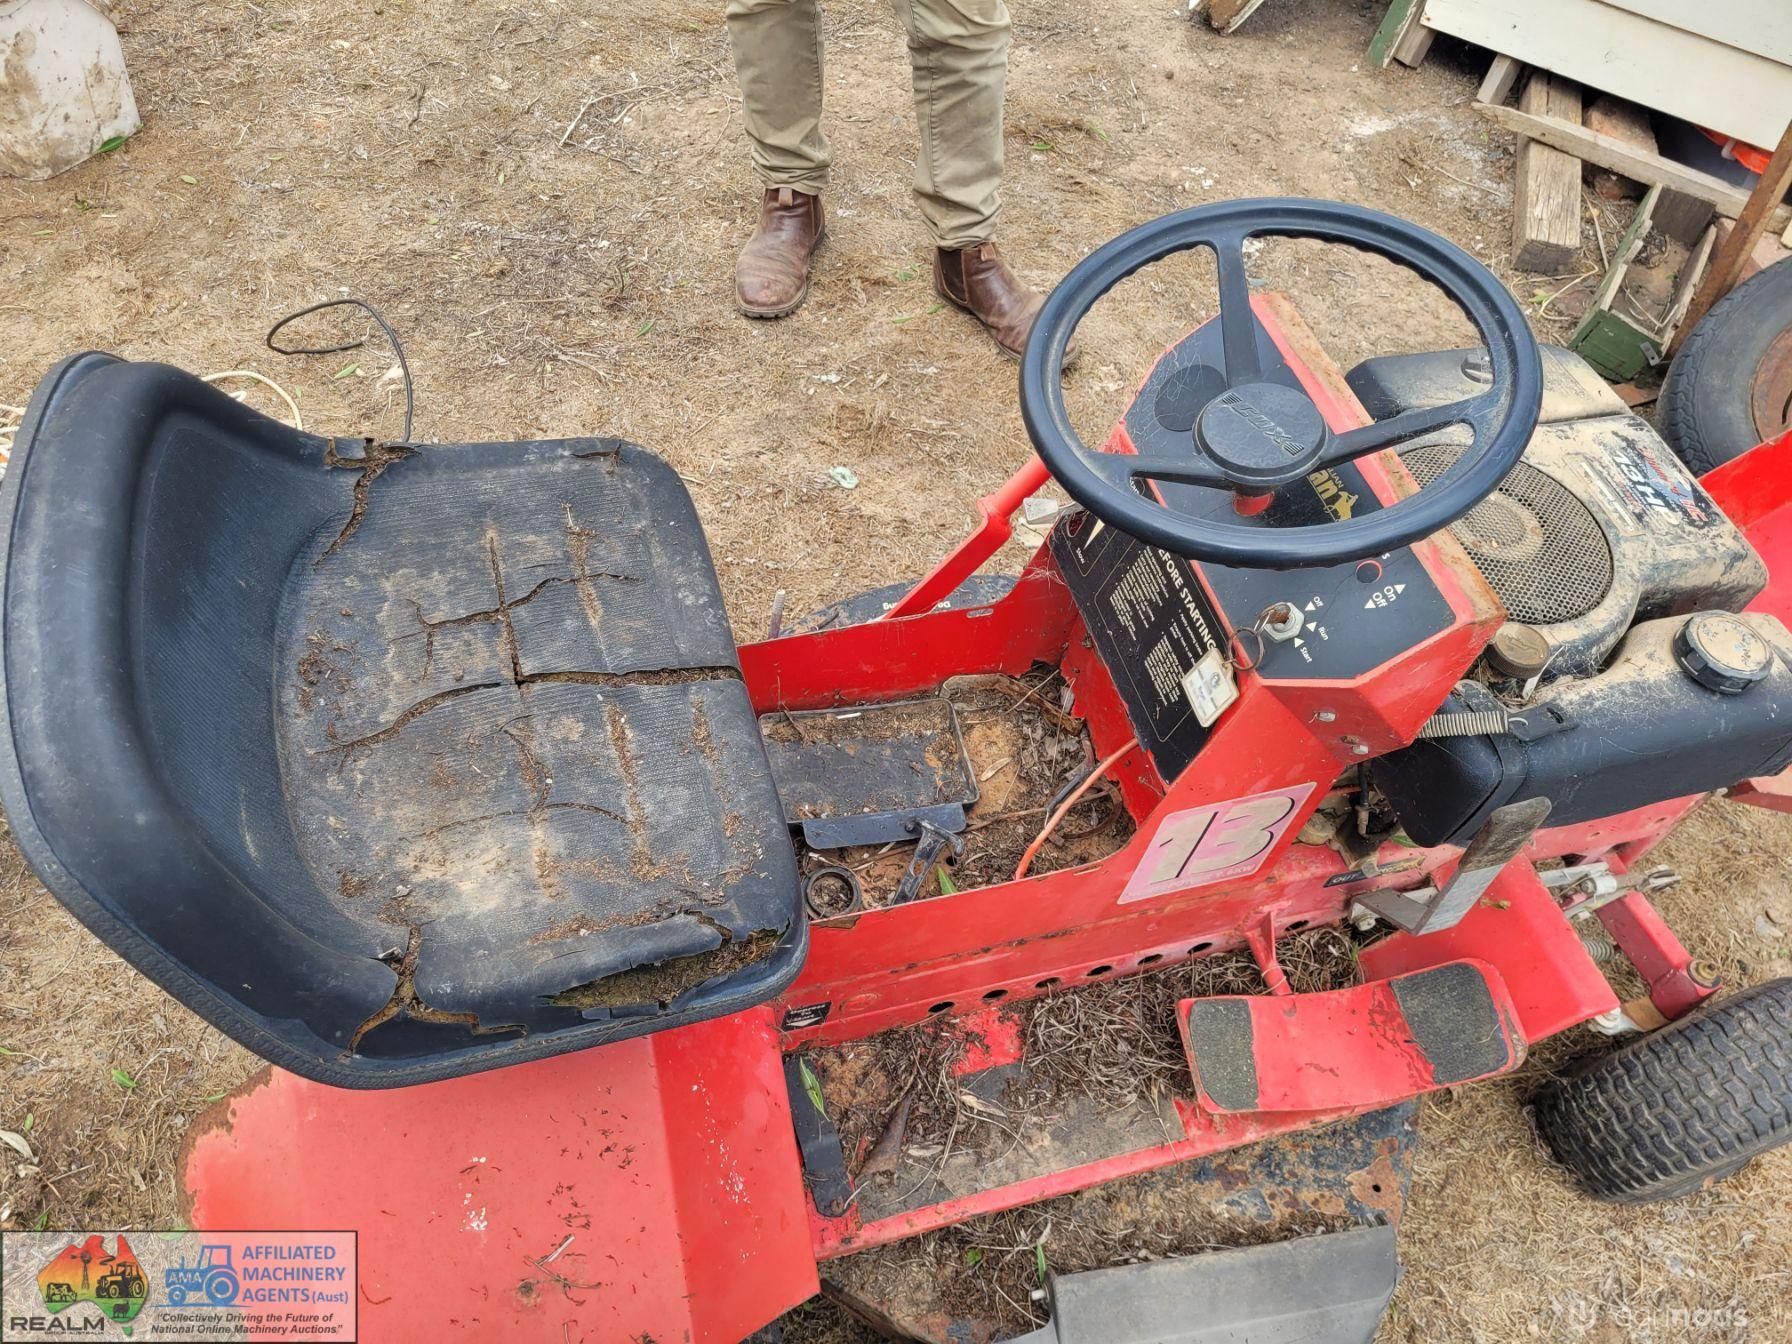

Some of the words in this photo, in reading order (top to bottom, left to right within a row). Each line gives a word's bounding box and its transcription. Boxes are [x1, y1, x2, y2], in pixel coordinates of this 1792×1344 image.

[1157, 547, 1183, 590] EFORE
[1372, 593, 1387, 608] Off
[1384, 585, 1397, 601] On
[1313, 596, 1323, 608] Off
[1317, 626, 1329, 641] Run
[1300, 646, 1313, 663] Start
[1150, 796, 1295, 885] 13
